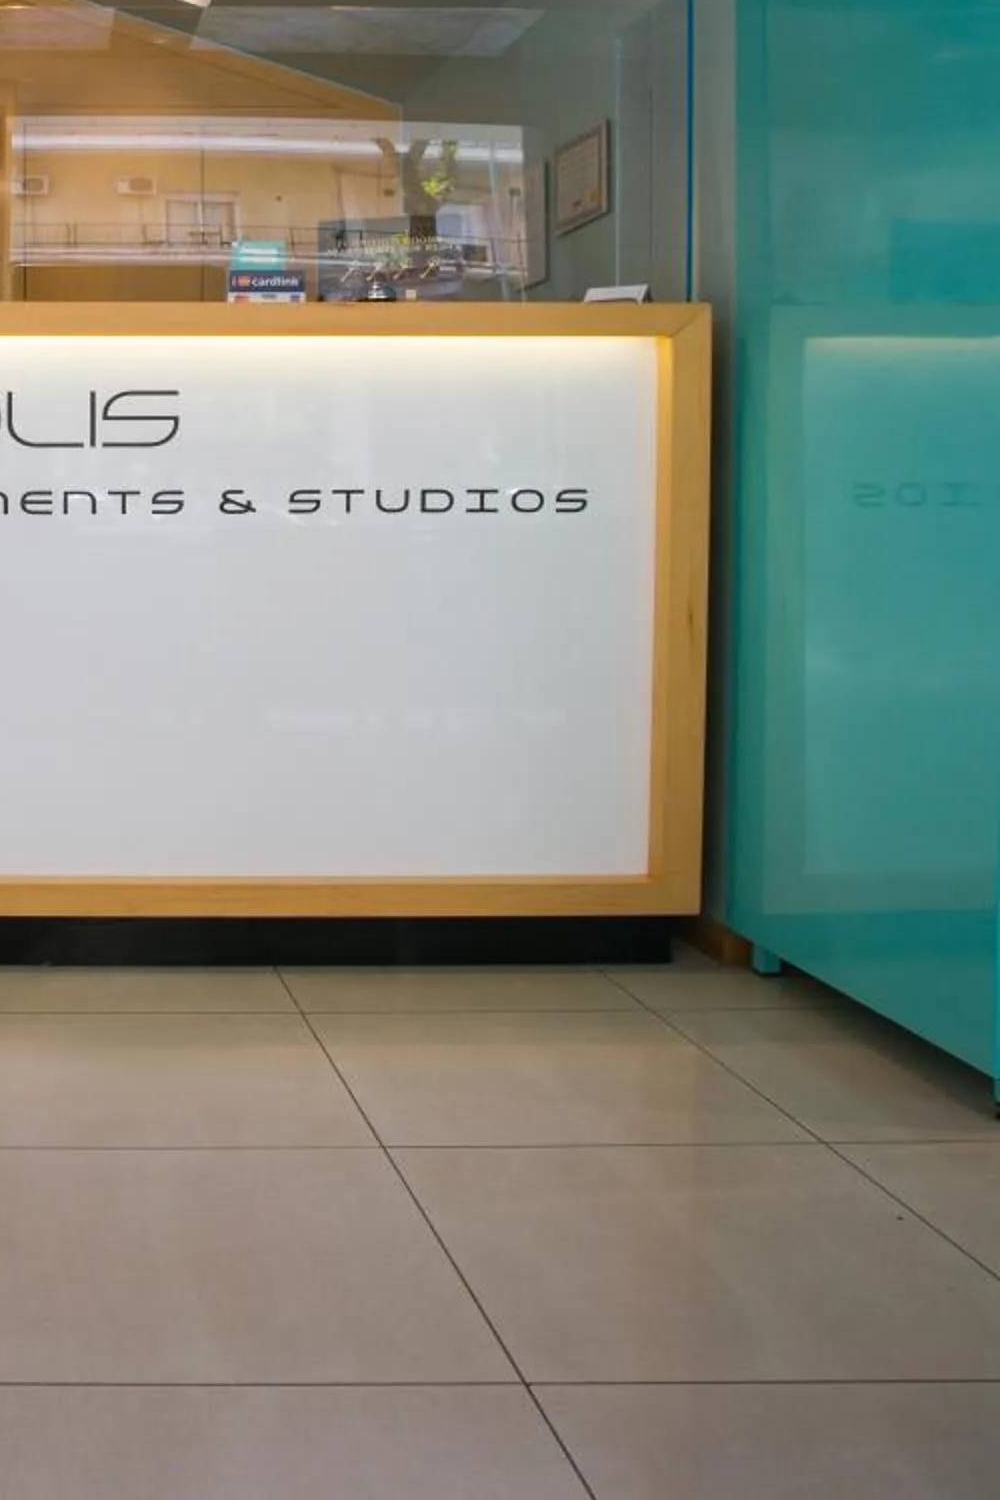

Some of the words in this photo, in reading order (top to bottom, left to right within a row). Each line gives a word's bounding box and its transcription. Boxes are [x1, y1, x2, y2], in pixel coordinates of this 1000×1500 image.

[251, 275, 299, 287] cardlink
[218, 489, 258, 515] &
[287, 488, 590, 515] STUDIOS
